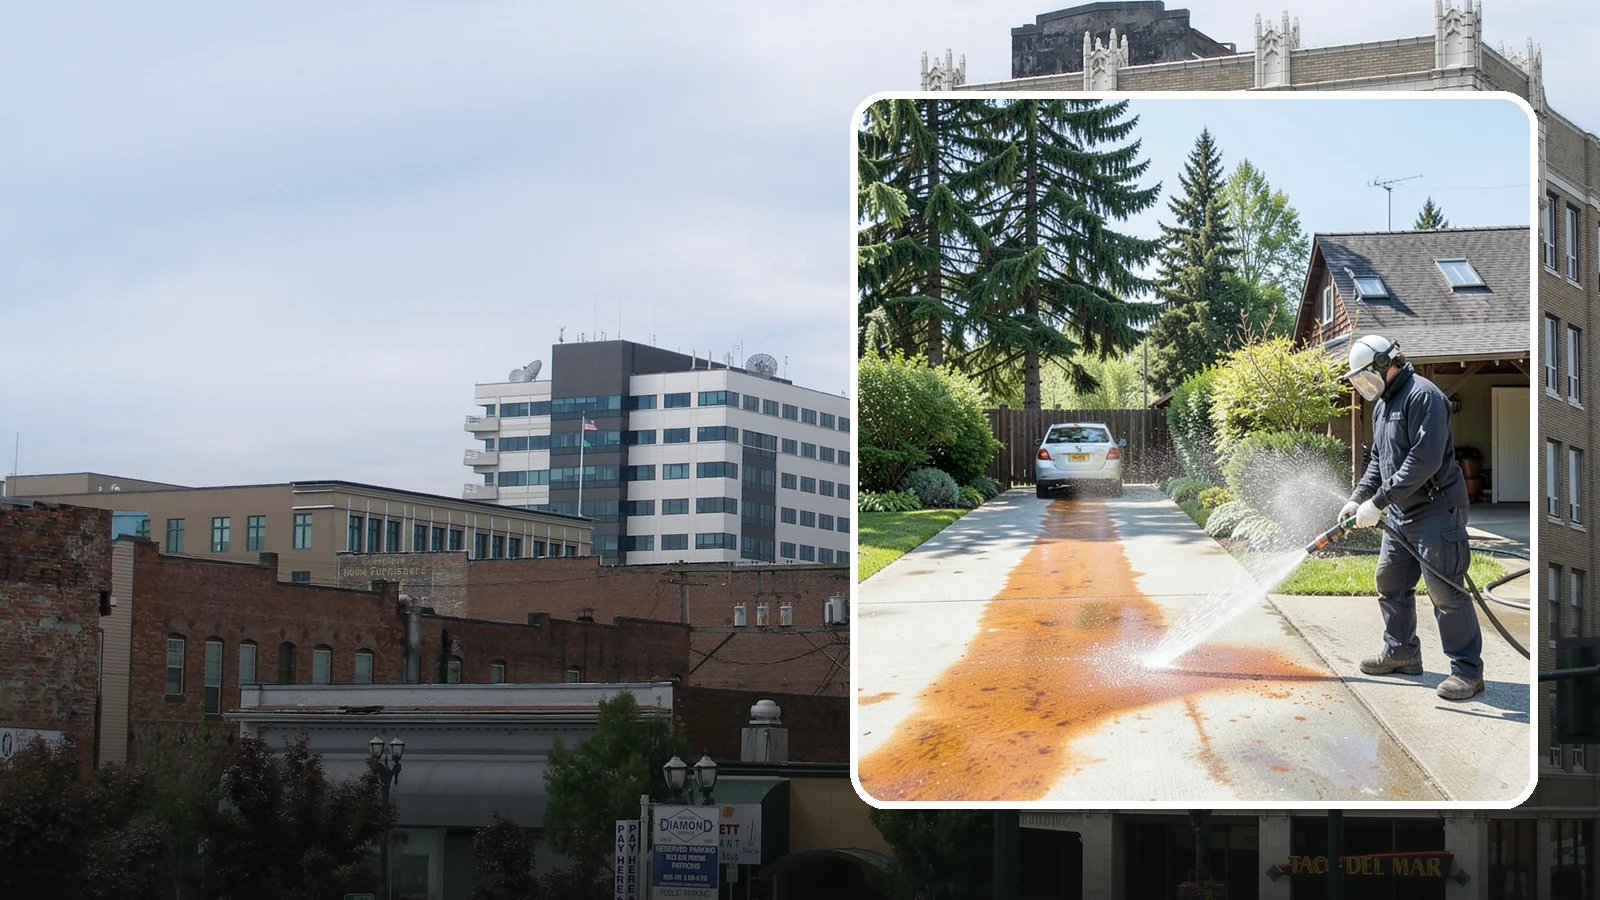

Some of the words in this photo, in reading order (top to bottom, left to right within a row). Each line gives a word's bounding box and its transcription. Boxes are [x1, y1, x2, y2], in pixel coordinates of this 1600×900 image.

[660, 818, 713, 833] DIAMOND
[1022, 815, 1069, 827] BUILDING
[617, 825, 625, 852] PAY
[628, 825, 636, 852] PAY
[656, 845, 688, 853] RESERVED
[690, 846, 716, 854] PARKING
[616, 856, 624, 893] HERE
[628, 856, 636, 893] HERE
[671, 862, 701, 870] PATRONS
[1346, 856, 1384, 875] DEL
[1393, 857, 1442, 876] MAR
[660, 888, 682, 897] PUBLIC
[684, 889, 710, 898] PARKING
